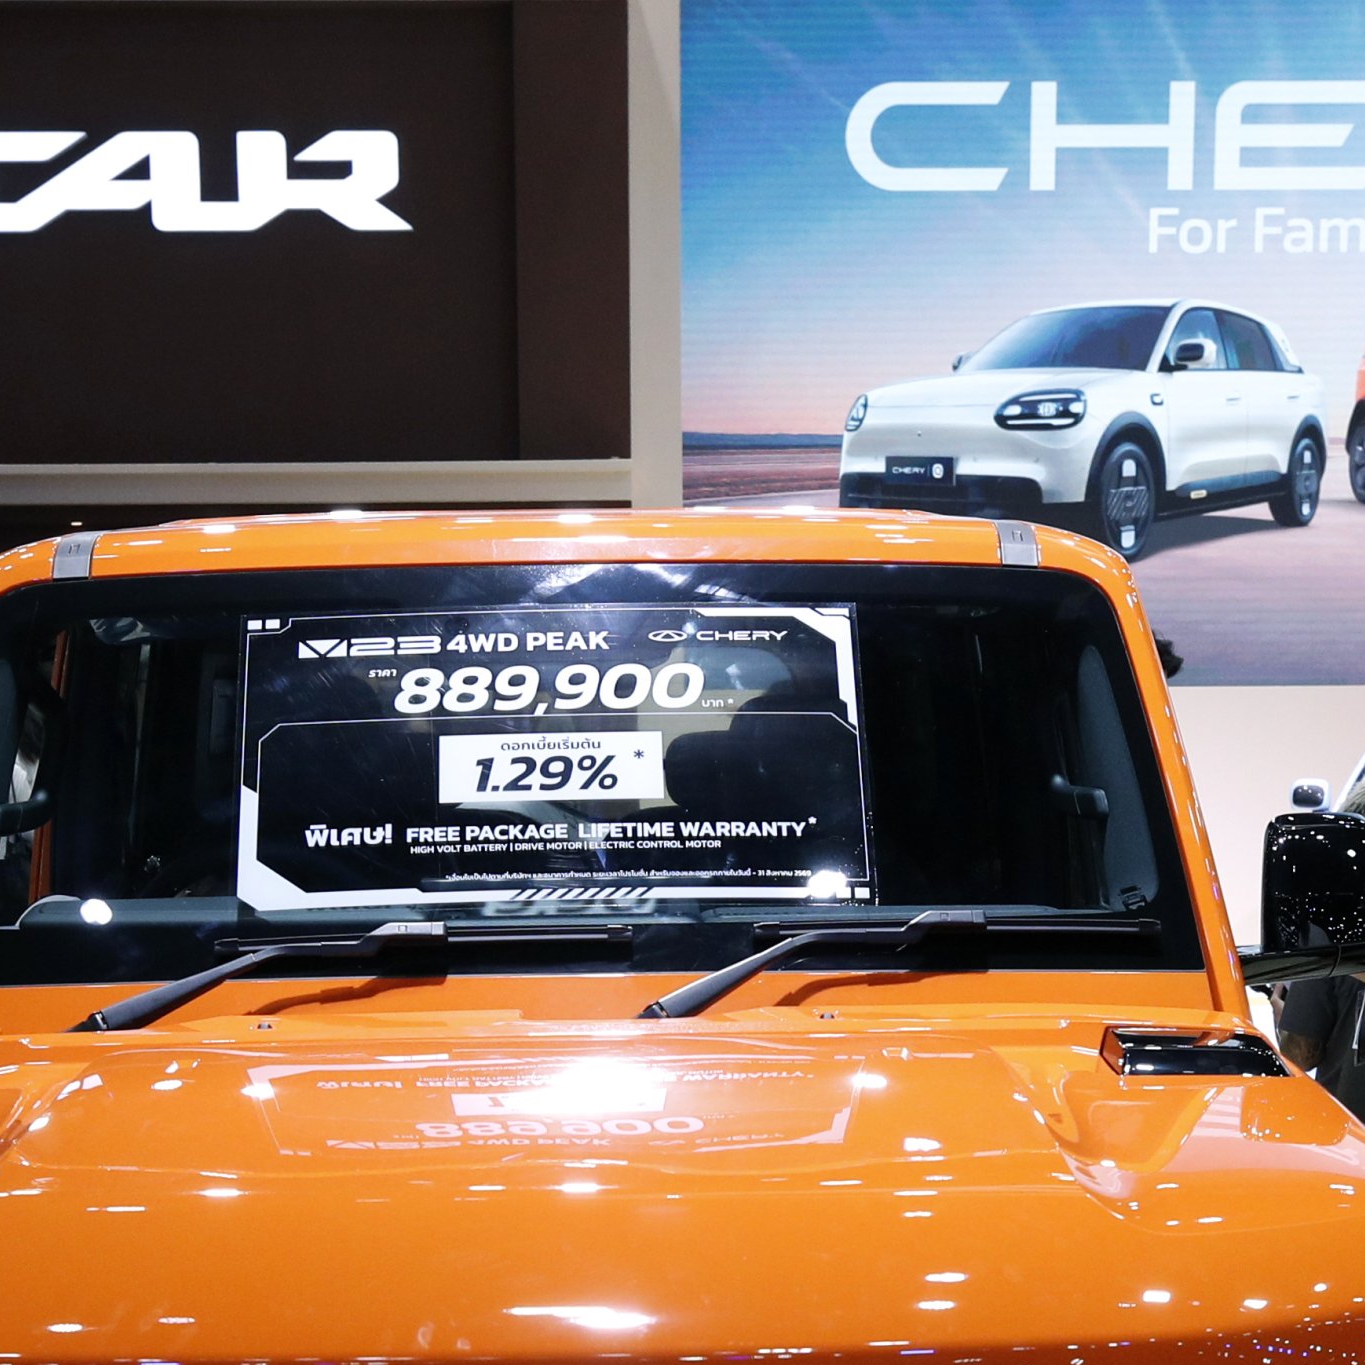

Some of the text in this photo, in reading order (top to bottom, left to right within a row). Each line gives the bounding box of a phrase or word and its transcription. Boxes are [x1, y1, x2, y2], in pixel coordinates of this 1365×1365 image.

[1147, 207, 1237, 255] For
[446, 633, 519, 653] 4WD
[527, 630, 611, 651] PEAK
[695, 629, 788, 641] CHERY
[394, 663, 704, 716] 889,900
[500, 736, 601, 751] ดอกเบี้ยเริ่มต้น
[305, 824, 392, 847] พิเศษ!
[406, 827, 460, 843] FREE
[465, 823, 568, 842] PACKAGE
[578, 821, 674, 838] LIFETIME
[410, 845, 434, 854] HIGH
[436, 844, 462, 853] VOLT
[463, 844, 508, 853] BATTERY
[514, 843, 545, 852] DRIVE
[547, 841, 582, 850] MOTOR
[588, 840, 635, 850] ELECTRIC
[636, 840, 683, 849] CONTROL
[685, 839, 721, 849] MOTOR
